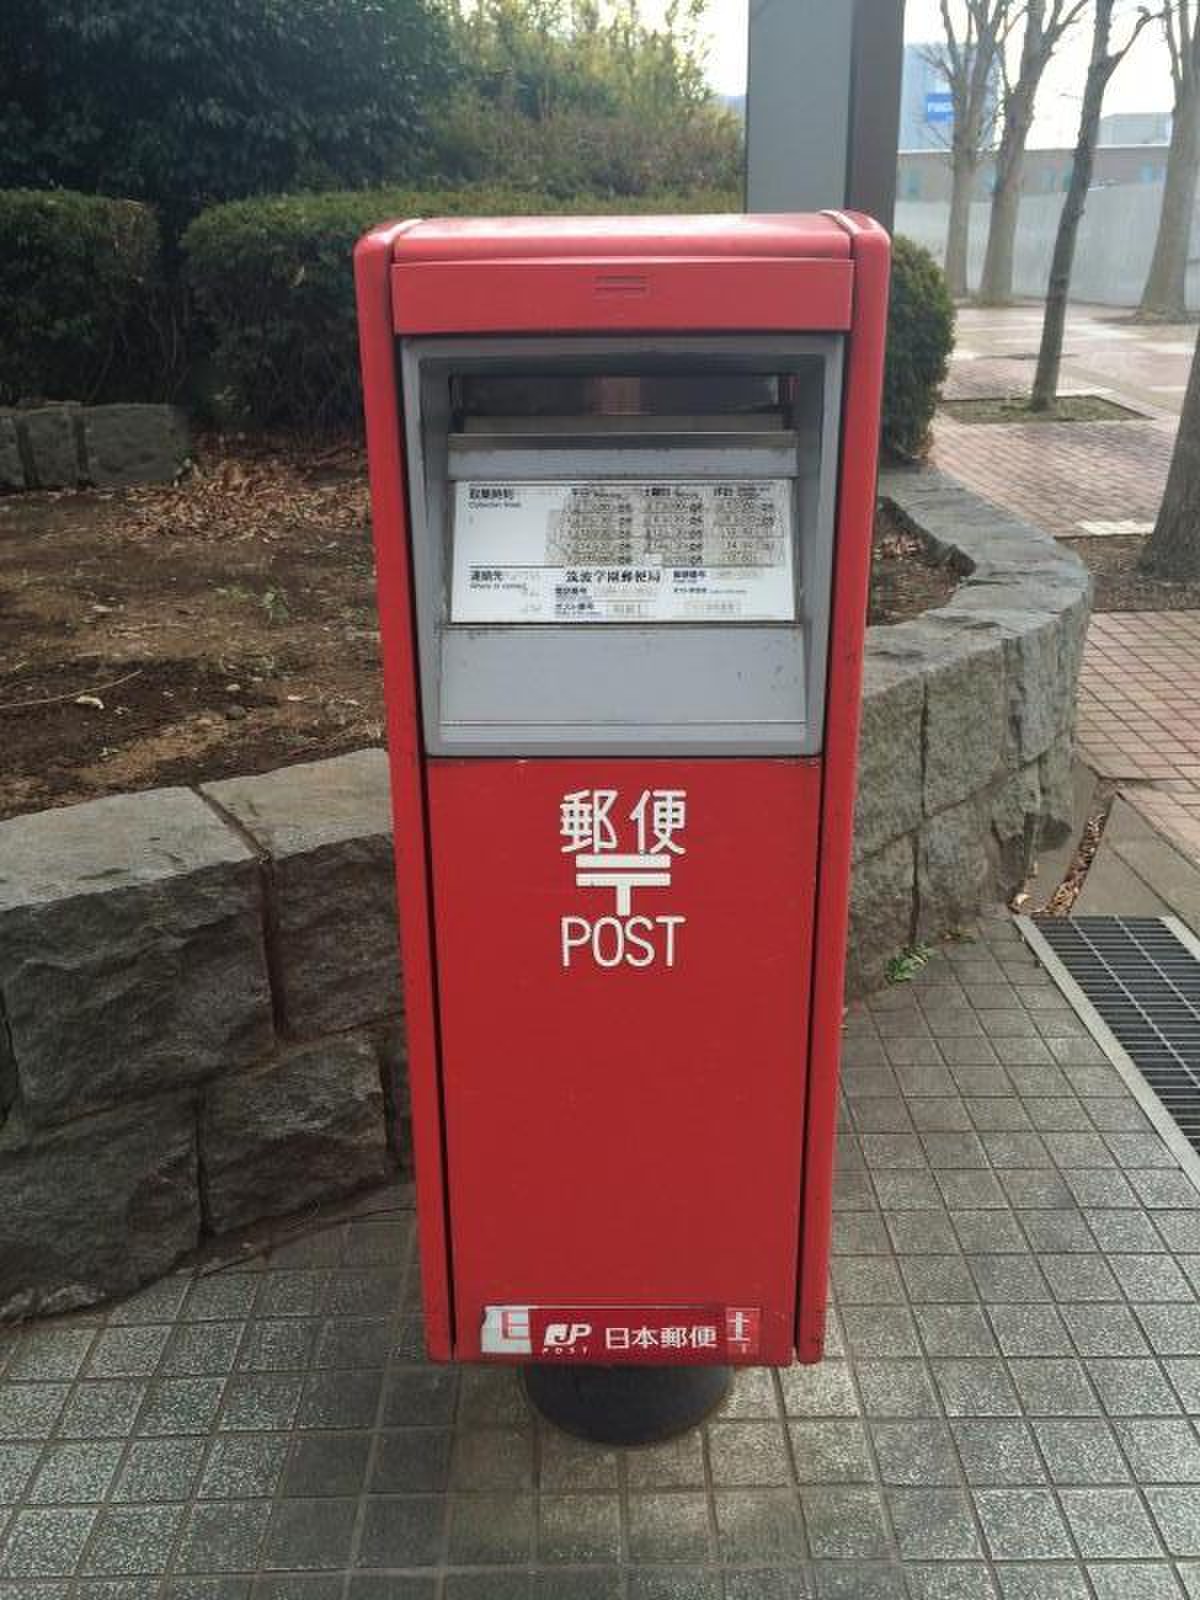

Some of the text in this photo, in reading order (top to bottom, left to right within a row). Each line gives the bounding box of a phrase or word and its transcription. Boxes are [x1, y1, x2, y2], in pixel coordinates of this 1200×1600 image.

[559, 788, 687, 855] 郵便
[560, 915, 687, 967] POST
[604, 1325, 718, 1350] 日本郵便
